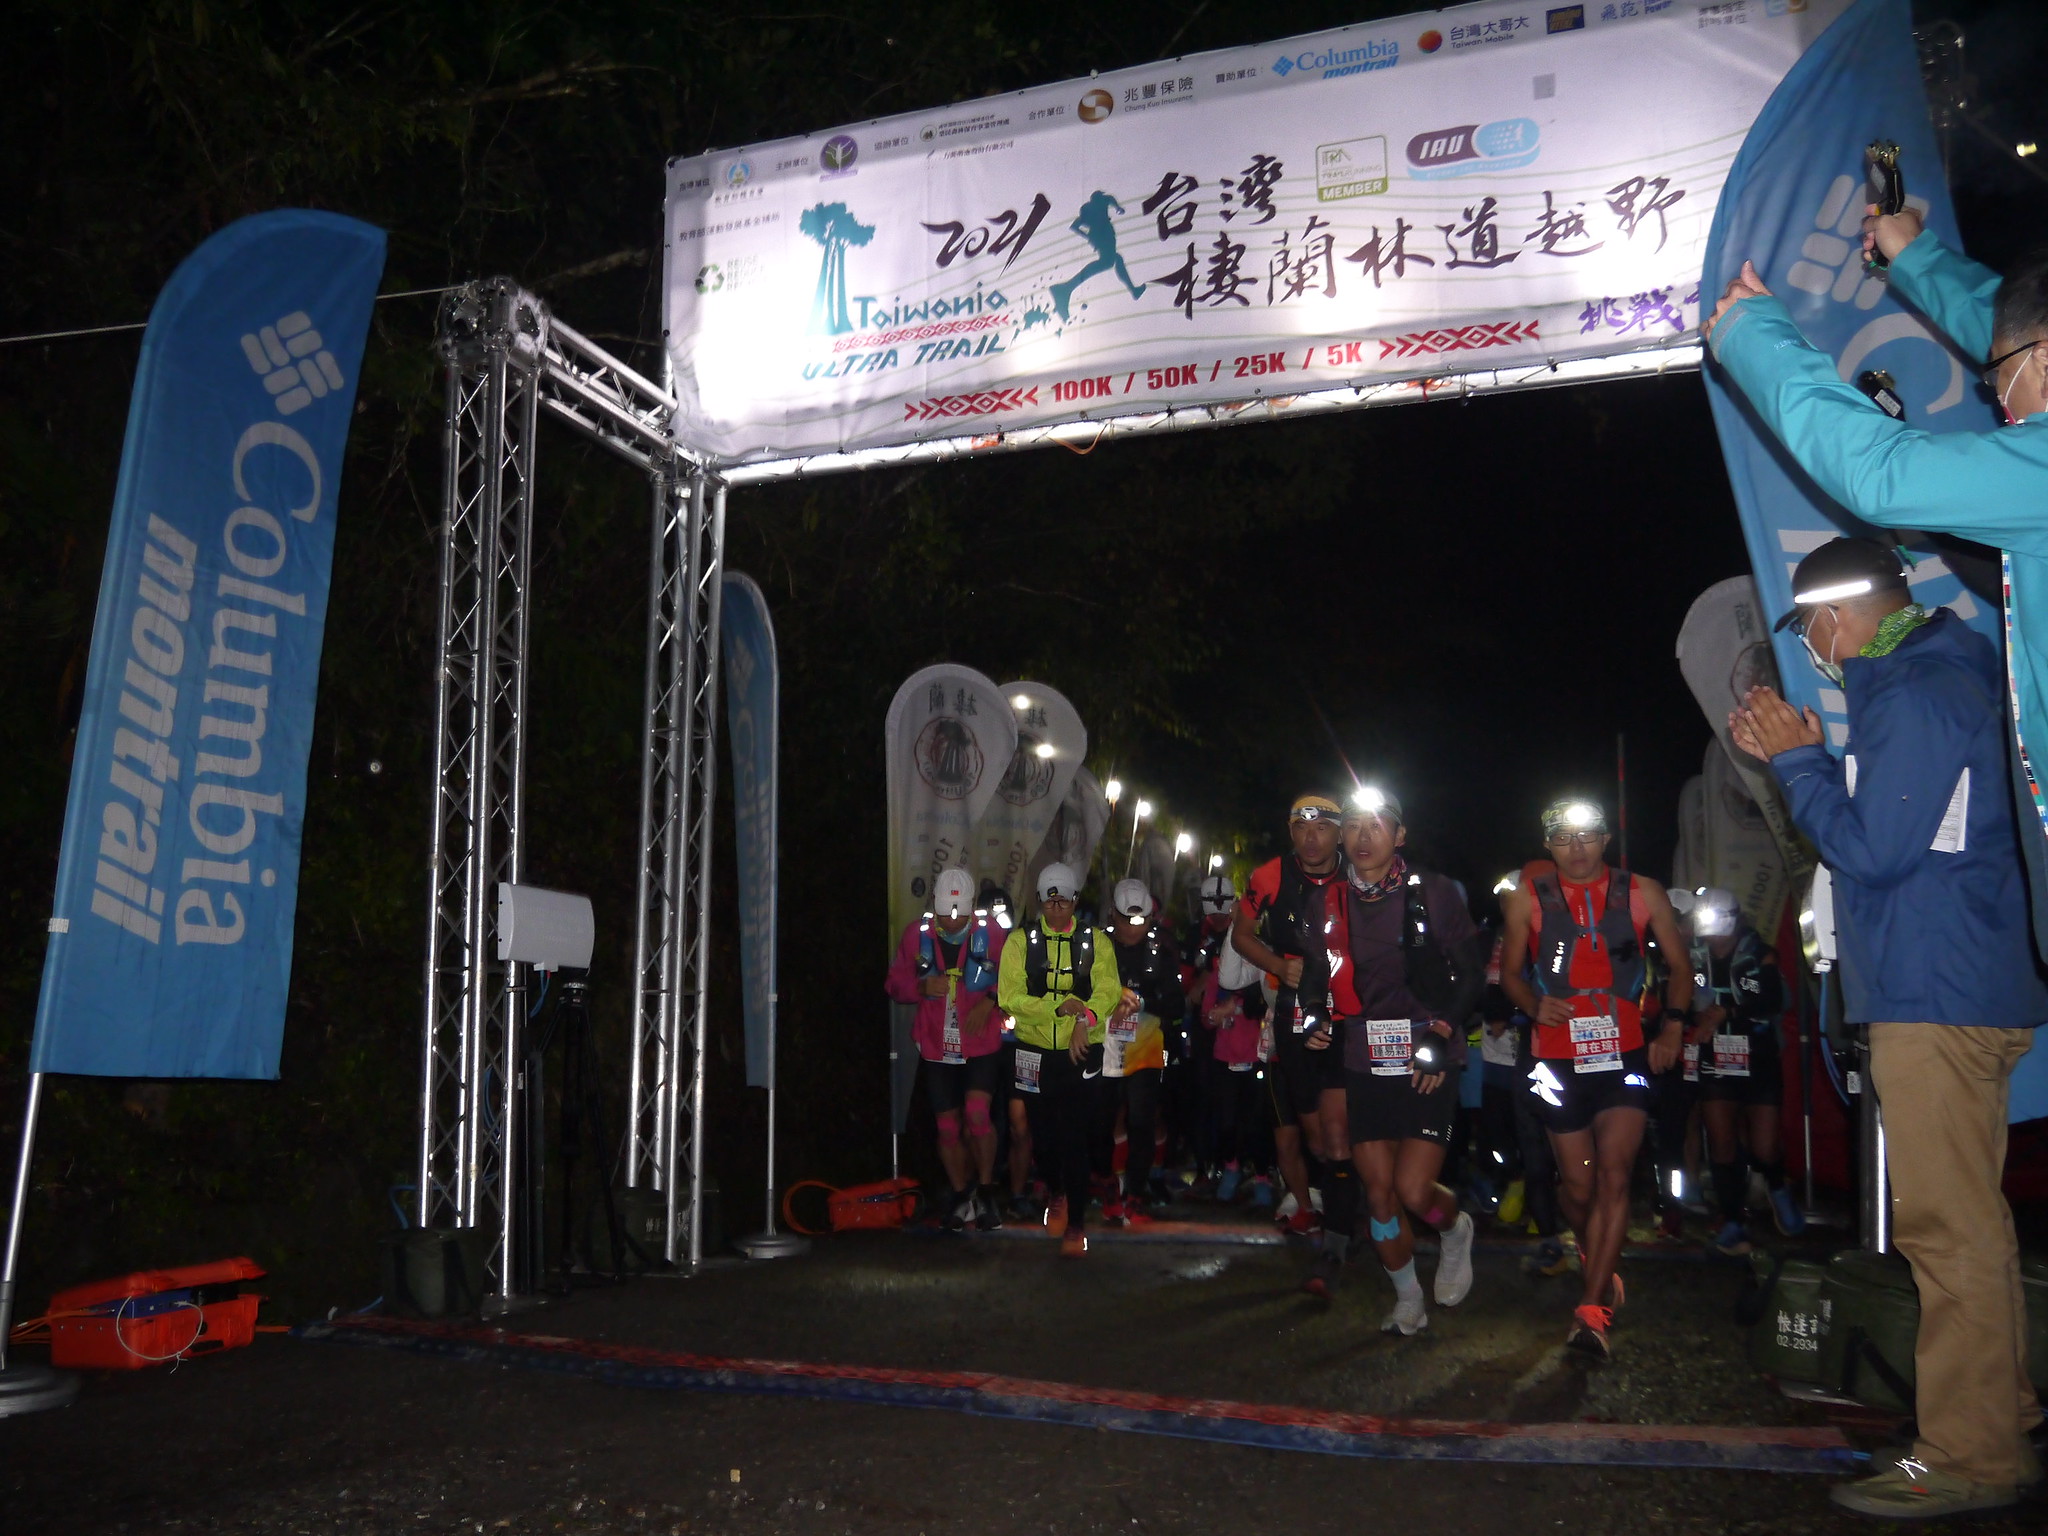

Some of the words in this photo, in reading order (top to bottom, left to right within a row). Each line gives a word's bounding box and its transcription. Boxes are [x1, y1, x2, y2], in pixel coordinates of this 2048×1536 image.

[1450, 16, 1530, 41] 台灣大哥大
[1451, 38, 1483, 49] Taiwan
[1485, 32, 1515, 44] Mobile
[1296, 40, 1399, 72] Columbia
[1322, 54, 1399, 80] montrail
[1123, 77, 1194, 102] 兆豐保險
[1124, 102, 1146, 113] Chung
[1161, 94, 1193, 106] Insurance
[1419, 134, 1465, 159] IAU
[1323, 180, 1383, 200] MEMBER
[920, 193, 1051, 277] 2021
[853, 281, 1009, 330] Taiwania
[1578, 280, 1702, 337] 挑戰
[802, 350, 898, 381] ULTRA
[913, 334, 1005, 367] TRAIL
[1051, 376, 1112, 403] 100K
[1148, 361, 1198, 391] 50K
[1234, 351, 1286, 379] 25K
[1327, 341, 1363, 367] 5K
[173, 420, 323, 947] Columbia
[89, 513, 199, 946] montrail
